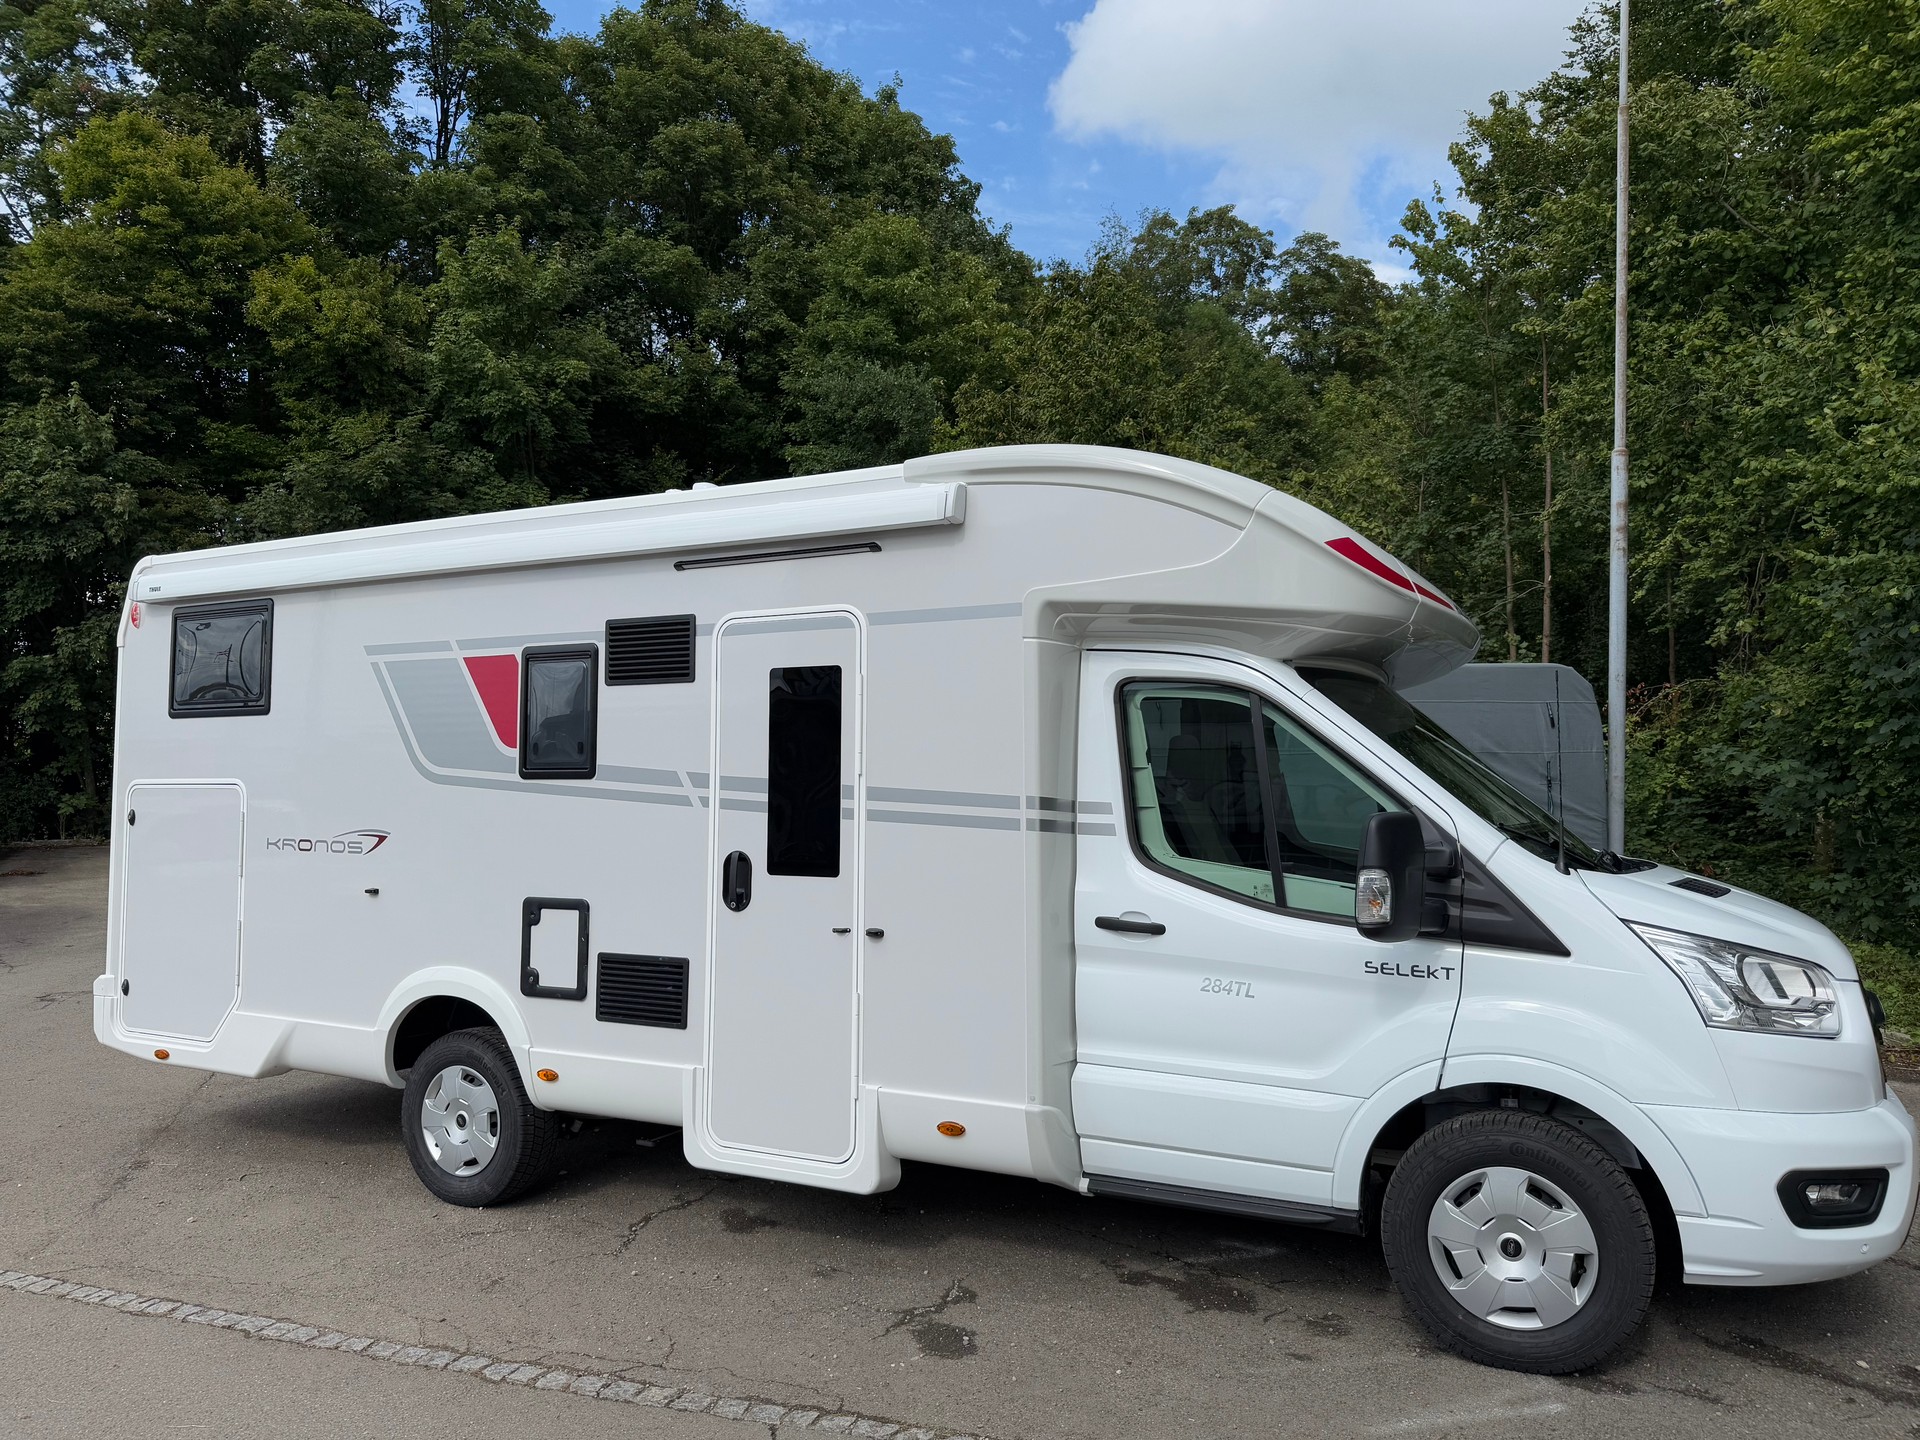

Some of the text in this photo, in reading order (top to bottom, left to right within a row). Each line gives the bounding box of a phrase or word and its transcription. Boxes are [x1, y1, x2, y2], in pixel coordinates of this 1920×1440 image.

[266, 837, 363, 854] KRONOS
[1364, 960, 1455, 980] SELEKT
[1200, 977, 1255, 999] 284TL
[1508, 1141, 1594, 1191] Continental
